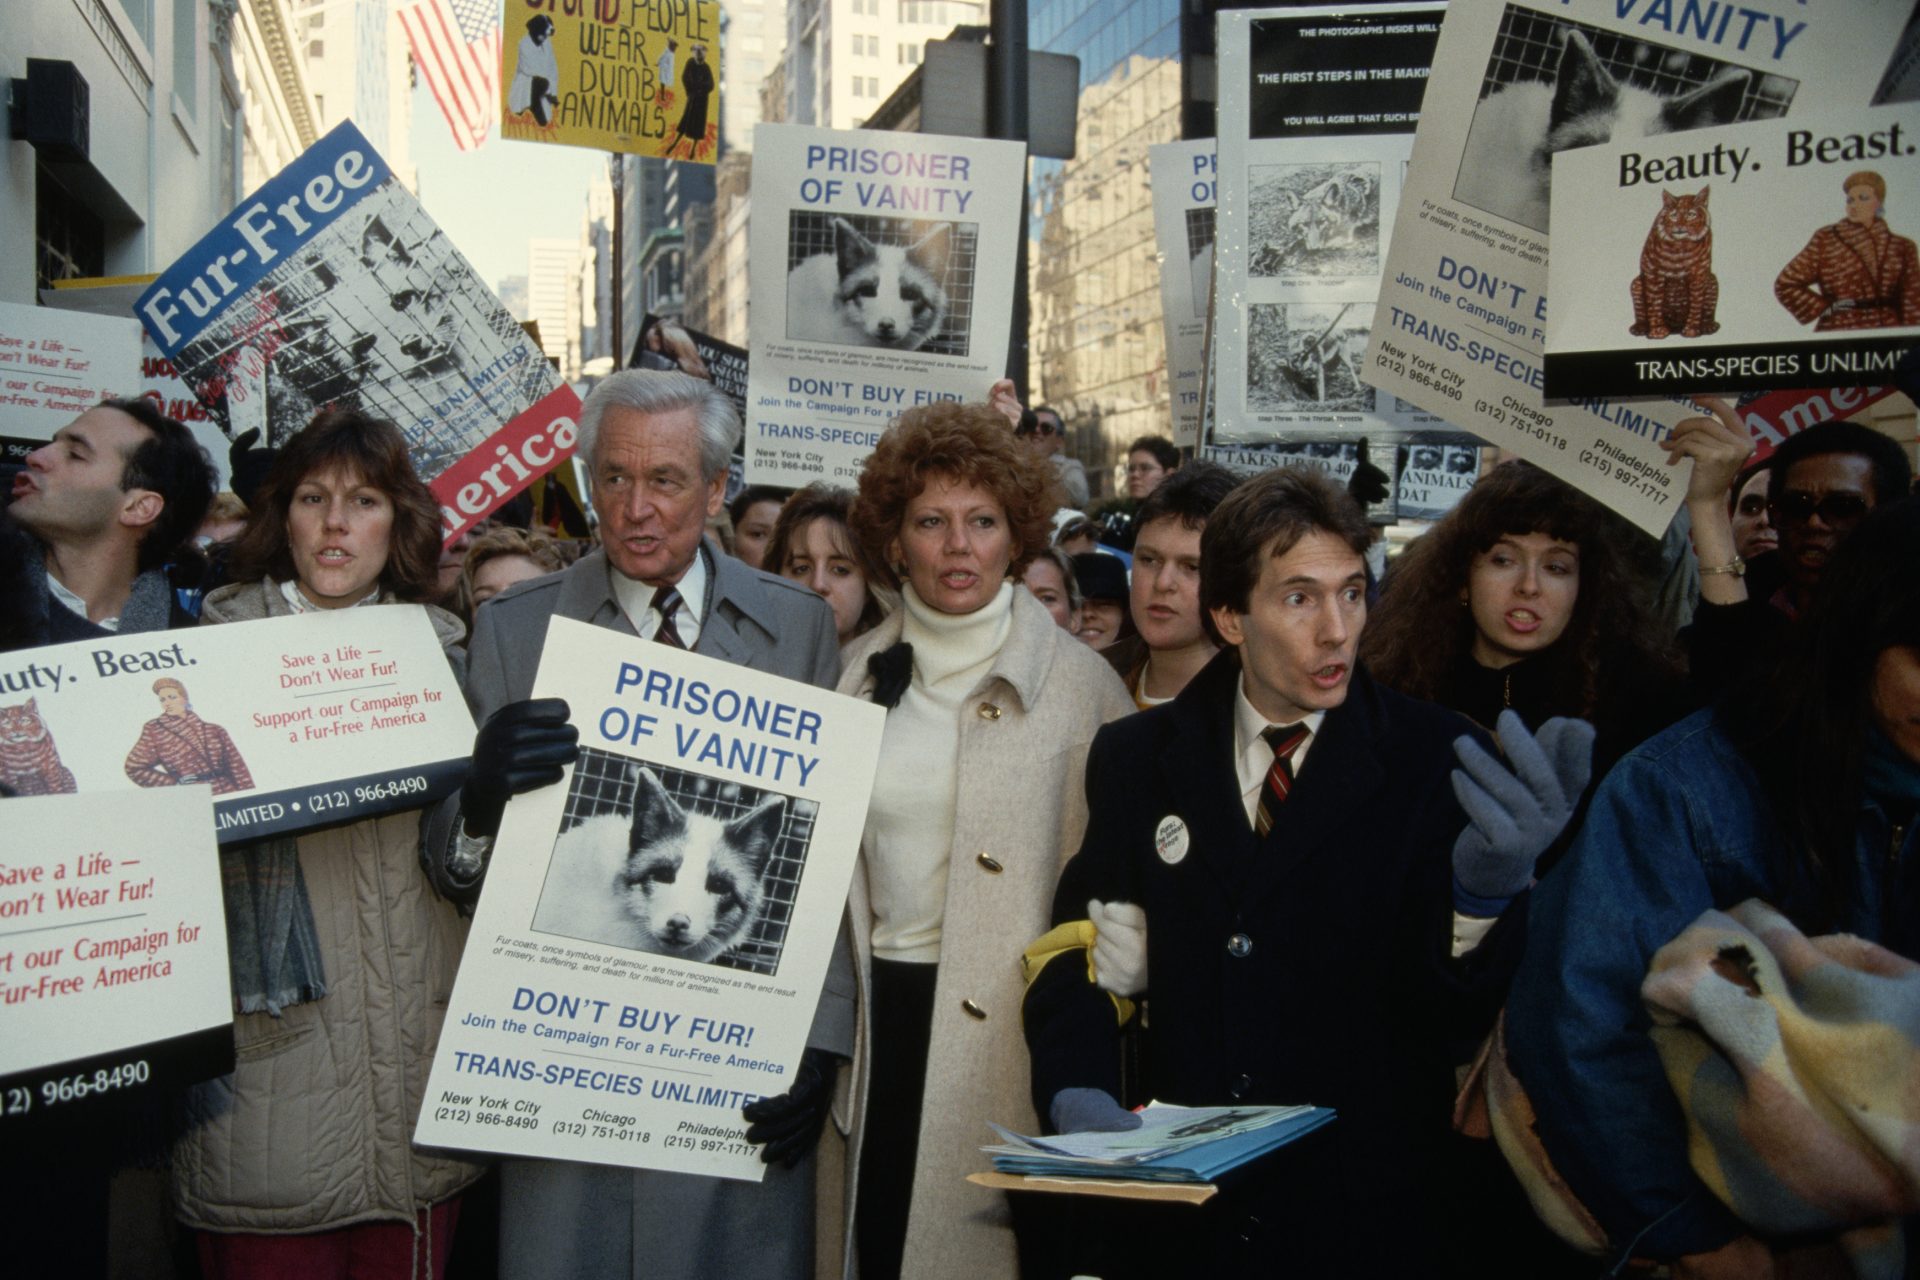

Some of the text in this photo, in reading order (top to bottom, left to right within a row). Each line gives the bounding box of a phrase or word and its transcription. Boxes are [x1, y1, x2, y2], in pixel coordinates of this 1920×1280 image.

[631, 0, 709, 42] PEOPLE
[1299, 28, 1317, 37] THE
[1318, 26, 1384, 36] PHOTOGRAPHS
[1386, 25, 1414, 34] INSIDE
[1416, 23, 1437, 32] WILL
[1615, 0, 1808, 60] VANITY
[580, 22, 647, 66] WEAR
[580, 60, 656, 102] DUMB
[1257, 73, 1279, 84] THE
[1282, 72, 1314, 83] FIRST
[1316, 71, 1352, 82] STEPS
[1354, 70, 1366, 80] IN
[1369, 69, 1392, 79] THE
[561, 92, 666, 139] ANIMALS
[1284, 117, 1302, 126] YOU
[1304, 116, 1325, 125] WILL
[1327, 114, 1355, 124] AGREE
[1357, 113, 1381, 122] THAT
[1383, 113, 1406, 122] SUCH
[807, 145, 971, 181] PRISONER
[1619, 122, 1916, 187] Beauty. Beast.
[800, 178, 973, 214] OF VANITY
[1419, 210, 1429, 219] of
[1430, 214, 1456, 233] misery,
[1460, 226, 1496, 248] suffering,
[1499, 242, 1516, 254] and
[1518, 249, 1542, 265] death
[1422, 199, 1436, 210] Fur
[1436, 205, 1459, 221] coats,
[1462, 215, 1482, 230] once
[1484, 223, 1518, 243] symbols
[1518, 237, 1528, 247] of
[143, 150, 374, 348] Fur-Free
[1438, 255, 1526, 309] DON'T
[1396, 272, 1424, 293] Join
[1429, 285, 1451, 303] the
[1456, 296, 1527, 336] Campaign
[28, 341, 35, 349] a
[28, 353, 59, 368] Wear
[1390, 306, 1545, 391] TRANS-SPECIE
[434, 344, 528, 418] UNLIMITED
[1376, 354, 1463, 401] (212) 966-8490
[1381, 340, 1465, 388] New York City
[1635, 354, 1799, 380] TRANS-SPECIES
[6, 380, 95, 400] our Campaign
[758, 396, 781, 408] Join
[785, 399, 801, 408] the
[806, 400, 860, 416] Campaign
[864, 406, 881, 417] For
[886, 410, 892, 418] a
[788, 377, 854, 398] DON'T
[862, 385, 906, 404] BUY
[1475, 399, 1567, 451] (312) 751-0118
[1501, 395, 1554, 428] Chicago
[758, 422, 880, 447] TRANS-SPECIE
[754, 459, 859, 478] (212) 966-8490 (312)
[756, 448, 824, 463] New York City
[1225, 449, 1279, 467] TAKES
[1335, 462, 1350, 476] 40
[1593, 438, 1671, 487] Philadelphia
[1402, 470, 1475, 491] ANIMALS
[1579, 449, 1668, 506] (215) 997-1717
[91, 643, 197, 678] Beast.
[279, 661, 398, 689] Don't Wear Fur!
[281, 645, 362, 669] Save a Life
[253, 688, 442, 729] Support our Campaign for
[615, 662, 822, 745] PRISONER
[289, 711, 426, 743] a Fur-Free America
[599, 707, 820, 787] OF VANITY
[308, 790, 349, 813] (212)
[354, 776, 427, 803] 966-8490
[54, 863, 65, 880] a
[77, 852, 112, 877] Life
[57, 887, 110, 911] Wear
[119, 878, 154, 902] Fur!
[24, 947, 64, 970] our
[74, 928, 168, 961] Campaign
[177, 921, 201, 945] for
[94, 957, 171, 990] America
[492, 946, 720, 996] of misery, suffering, and death for millions of animals.
[495, 935, 511, 945] Fur
[512, 939, 538, 951] coats,
[542, 944, 564, 955] once
[565, 949, 601, 962] symbols
[613, 957, 649, 972] glamour,
[651, 966, 665, 974] are
[666, 968, 685, 977] now
[686, 971, 731, 987] recognized
[732, 980, 742, 988] as
[743, 981, 756, 991] the
[758, 984, 774, 994] end
[773, 987, 796, 998] result
[512, 987, 755, 1049] DON'T BUY FUR!
[461, 1012, 785, 1075] Join the Campaign For a Fur-Free America
[42, 1061, 150, 1105] 966-8490
[454, 1051, 643, 1096] TRANS-SPECIES
[435, 1106, 539, 1130] (212) 966-8490
[441, 1091, 541, 1116] New York City
[582, 1108, 636, 1128] Chicago
[552, 1120, 650, 1143] (312) 751-0118
[664, 1135, 757, 1157] (215) 997-1717
[677, 1121, 747, 1141] Philadelph
